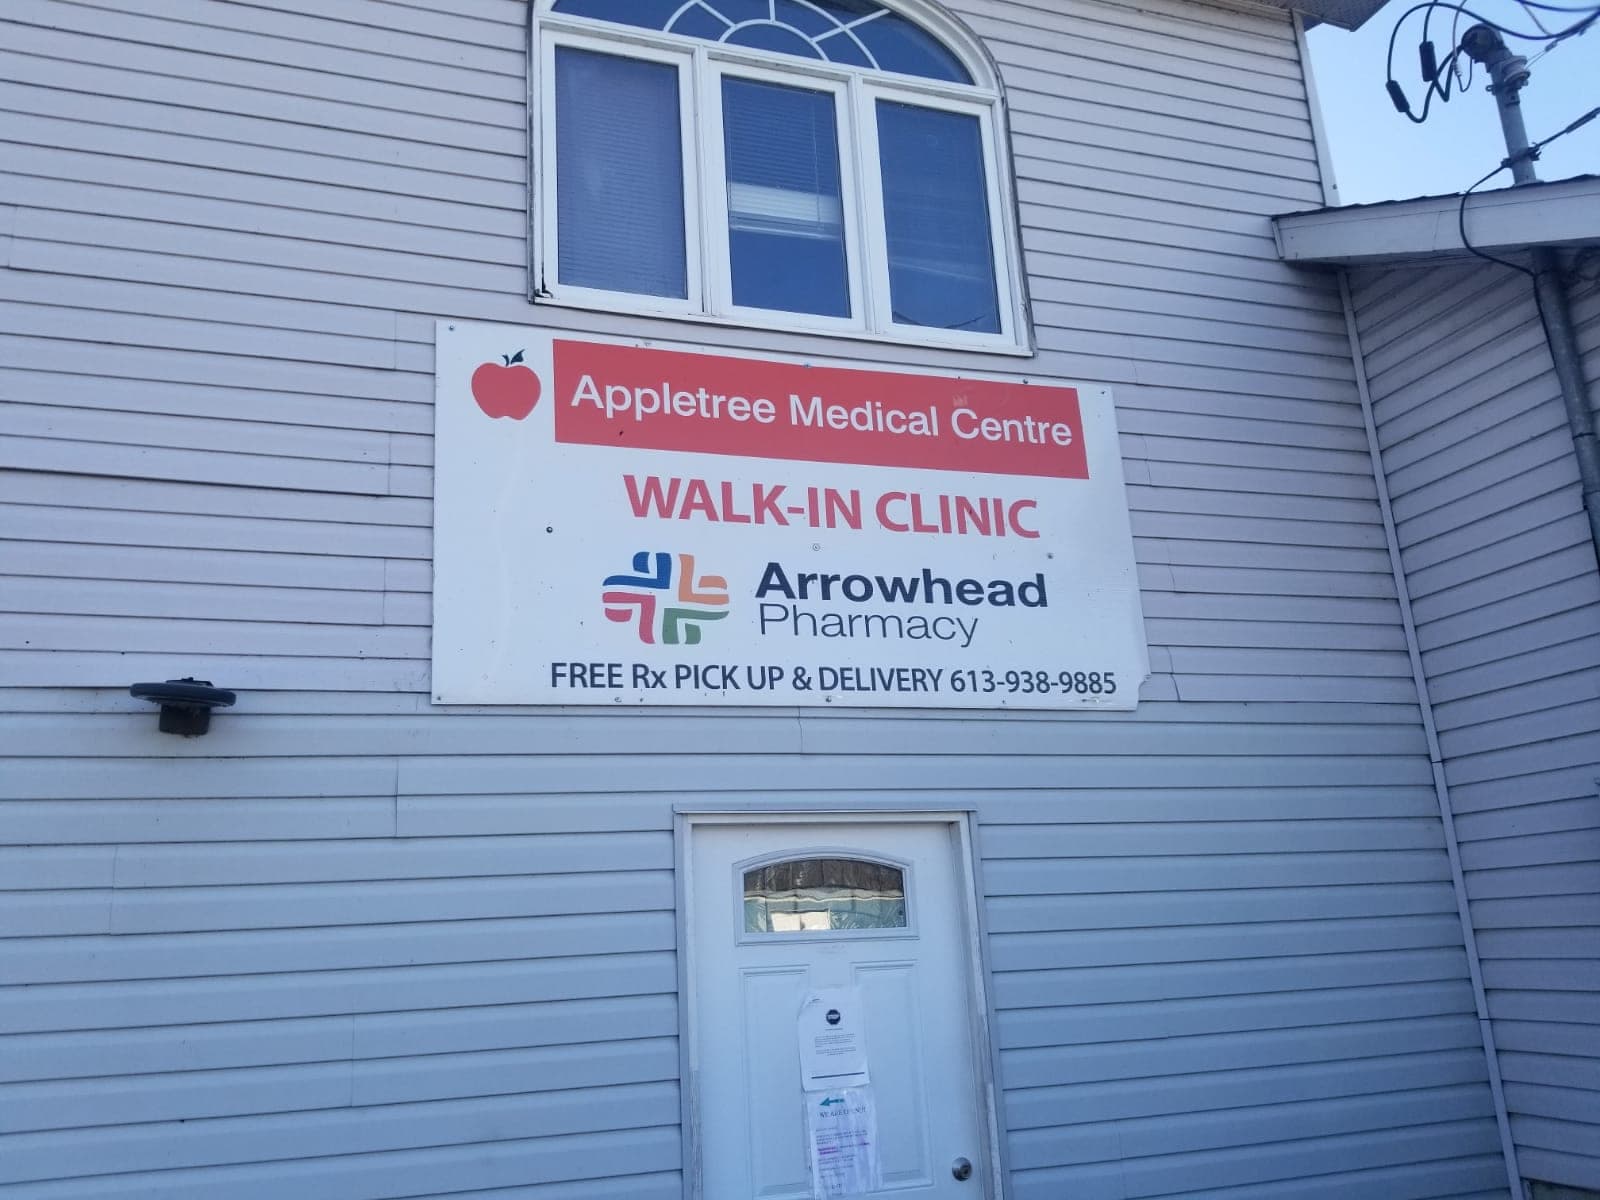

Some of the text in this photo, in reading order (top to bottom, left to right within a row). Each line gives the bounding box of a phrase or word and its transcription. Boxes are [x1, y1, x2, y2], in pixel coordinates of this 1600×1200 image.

[570, 374, 1072, 446] Appletree Medical Centre
[623, 475, 1039, 538] WALK-IN CLINIC
[755, 562, 1048, 608] Arrowhead
[759, 603, 978, 648] Pharmacy
[551, 662, 1117, 695] FREE Rx PICK UP & DELIVERY 613-938-9885
